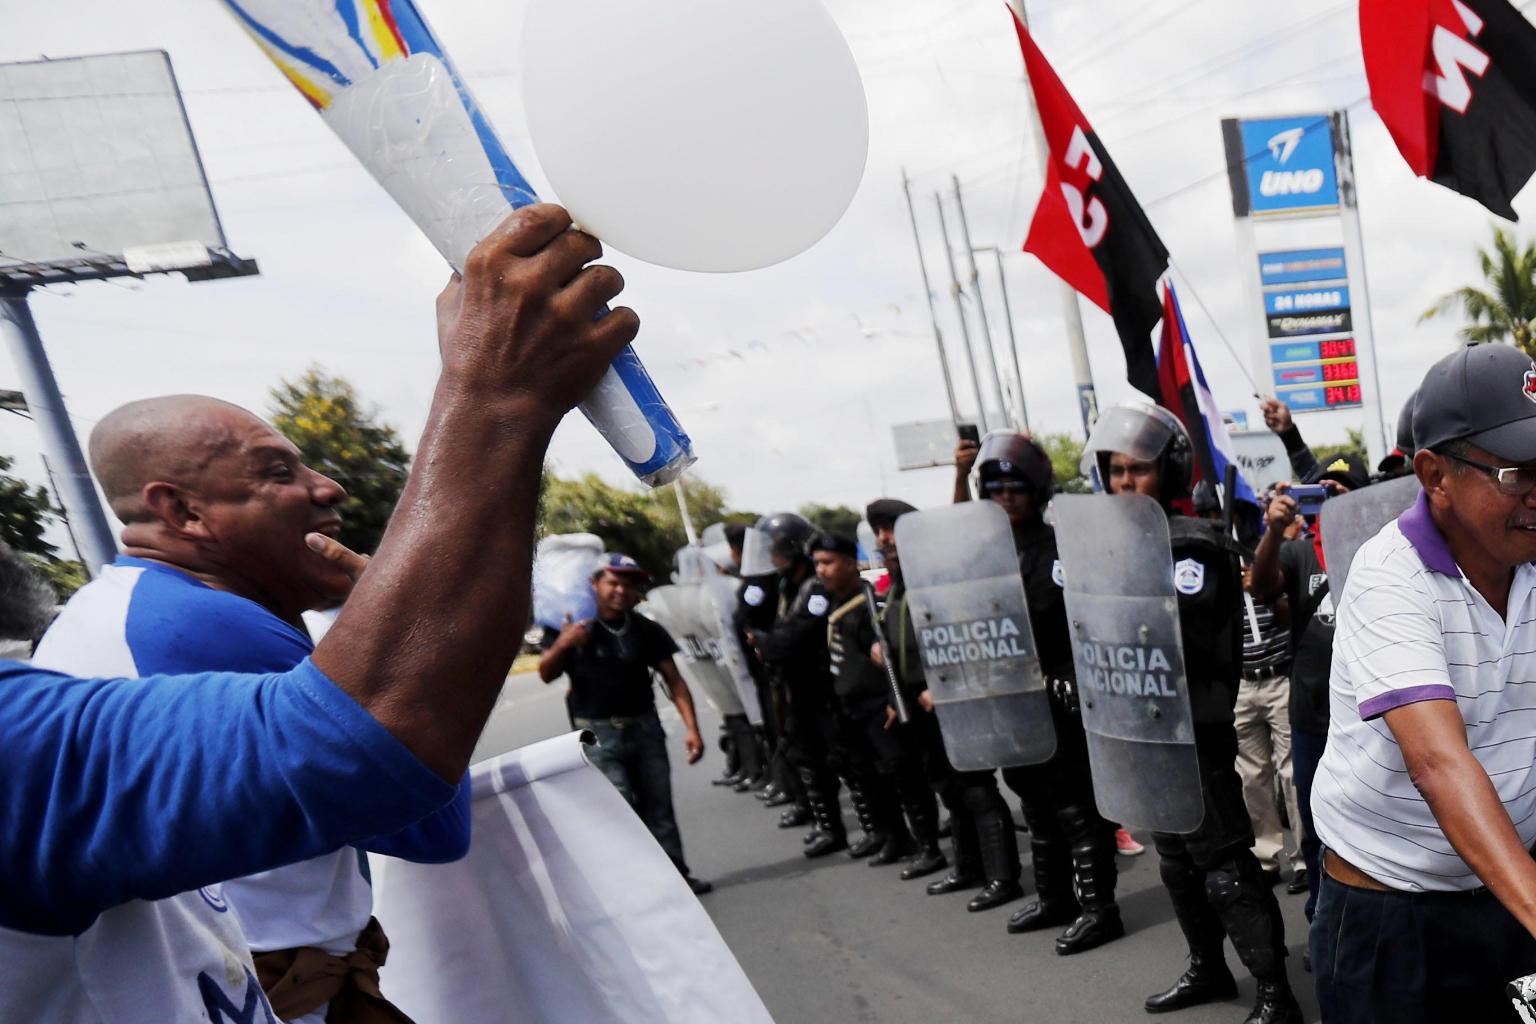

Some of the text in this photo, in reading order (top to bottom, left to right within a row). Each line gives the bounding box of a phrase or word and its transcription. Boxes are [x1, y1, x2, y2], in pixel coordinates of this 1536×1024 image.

[1260, 168, 1324, 197] UNO
[921, 617, 1020, 647] POLICIA
[925, 637, 1026, 667] NACIONAL
[1081, 666, 1177, 697] ACIONAL
